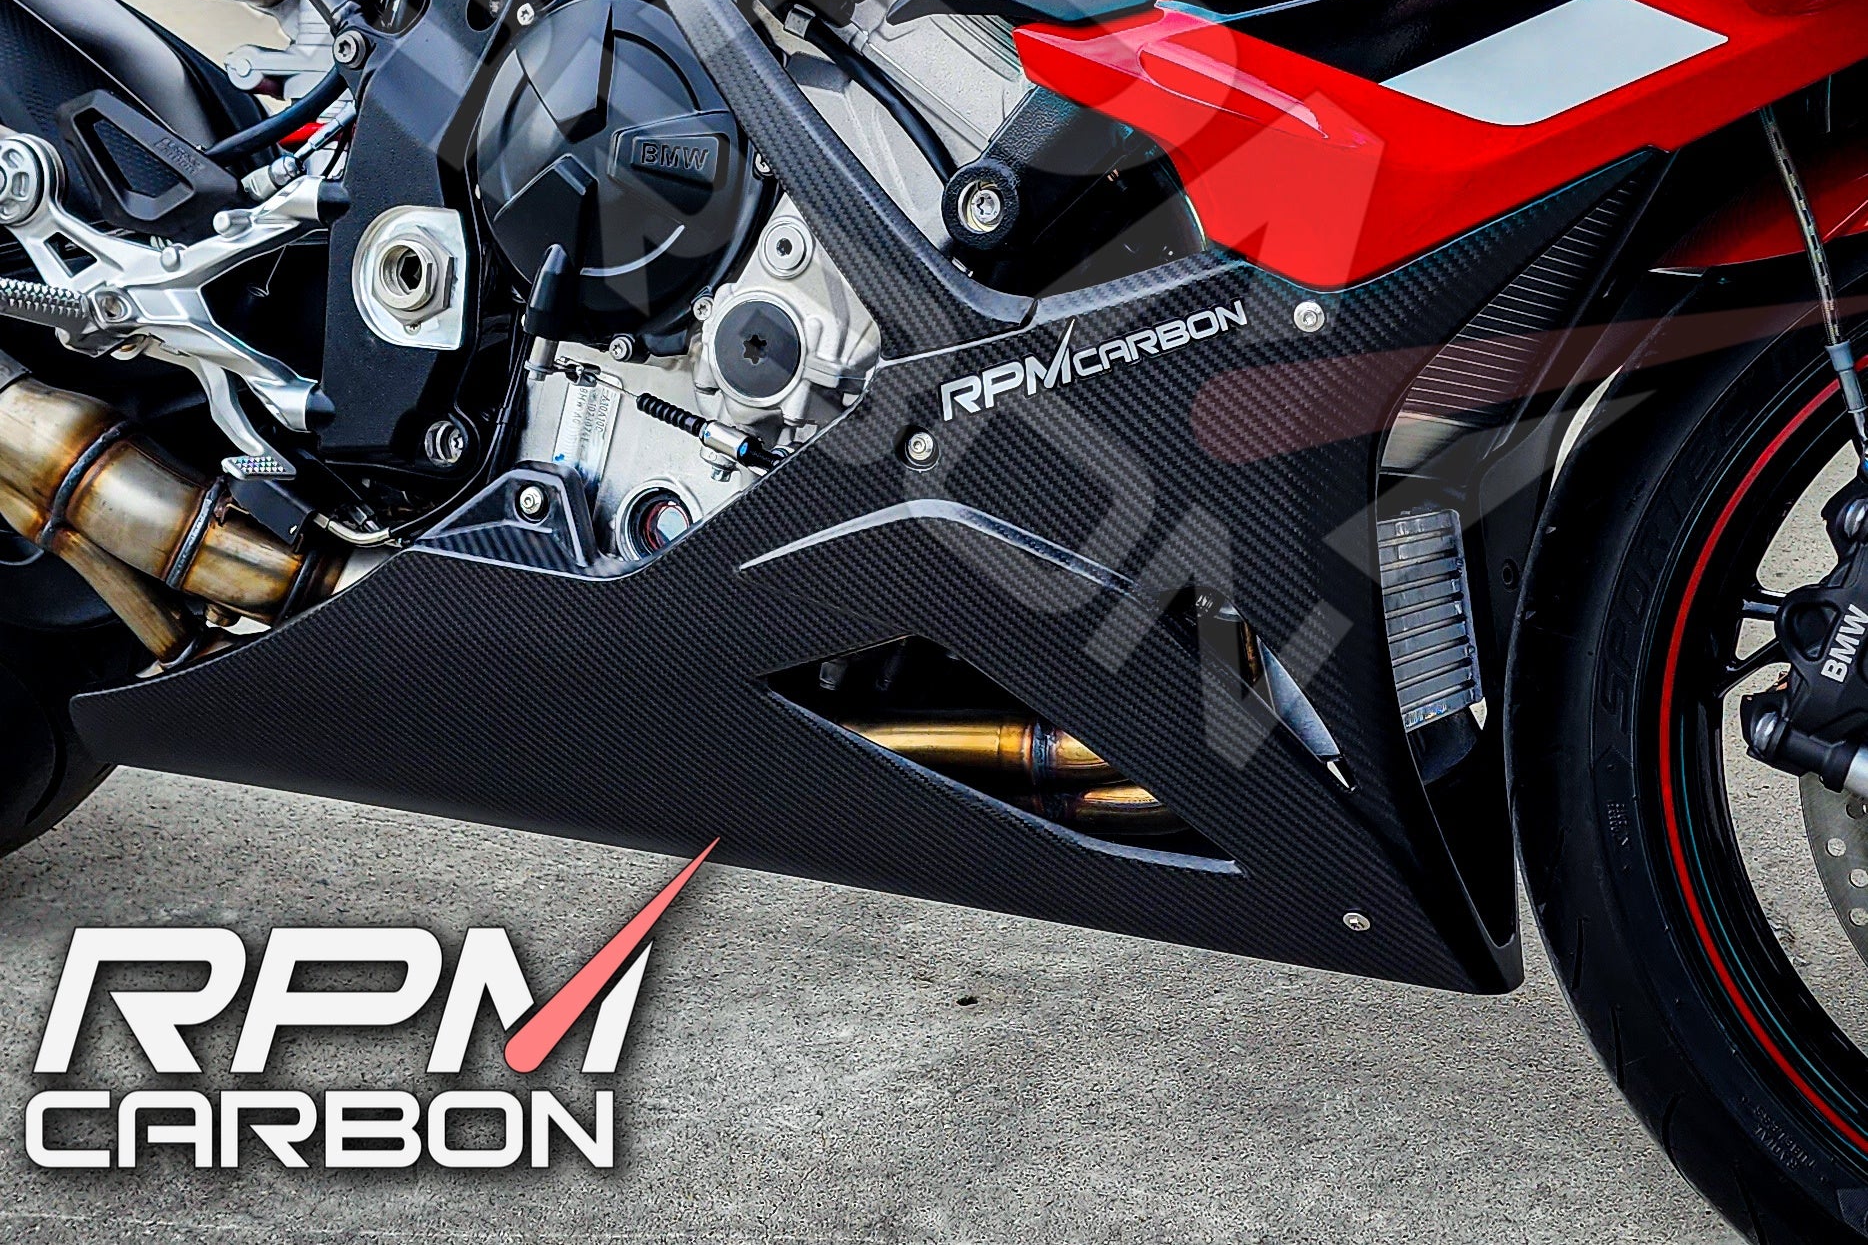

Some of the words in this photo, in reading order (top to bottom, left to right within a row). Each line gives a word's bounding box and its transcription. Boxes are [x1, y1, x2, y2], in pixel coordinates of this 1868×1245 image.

[641, 142, 709, 171] BMW
[940, 318, 1075, 421] RPM
[1073, 300, 1247, 377] CARBON
[1821, 603, 1868, 683] BMW
